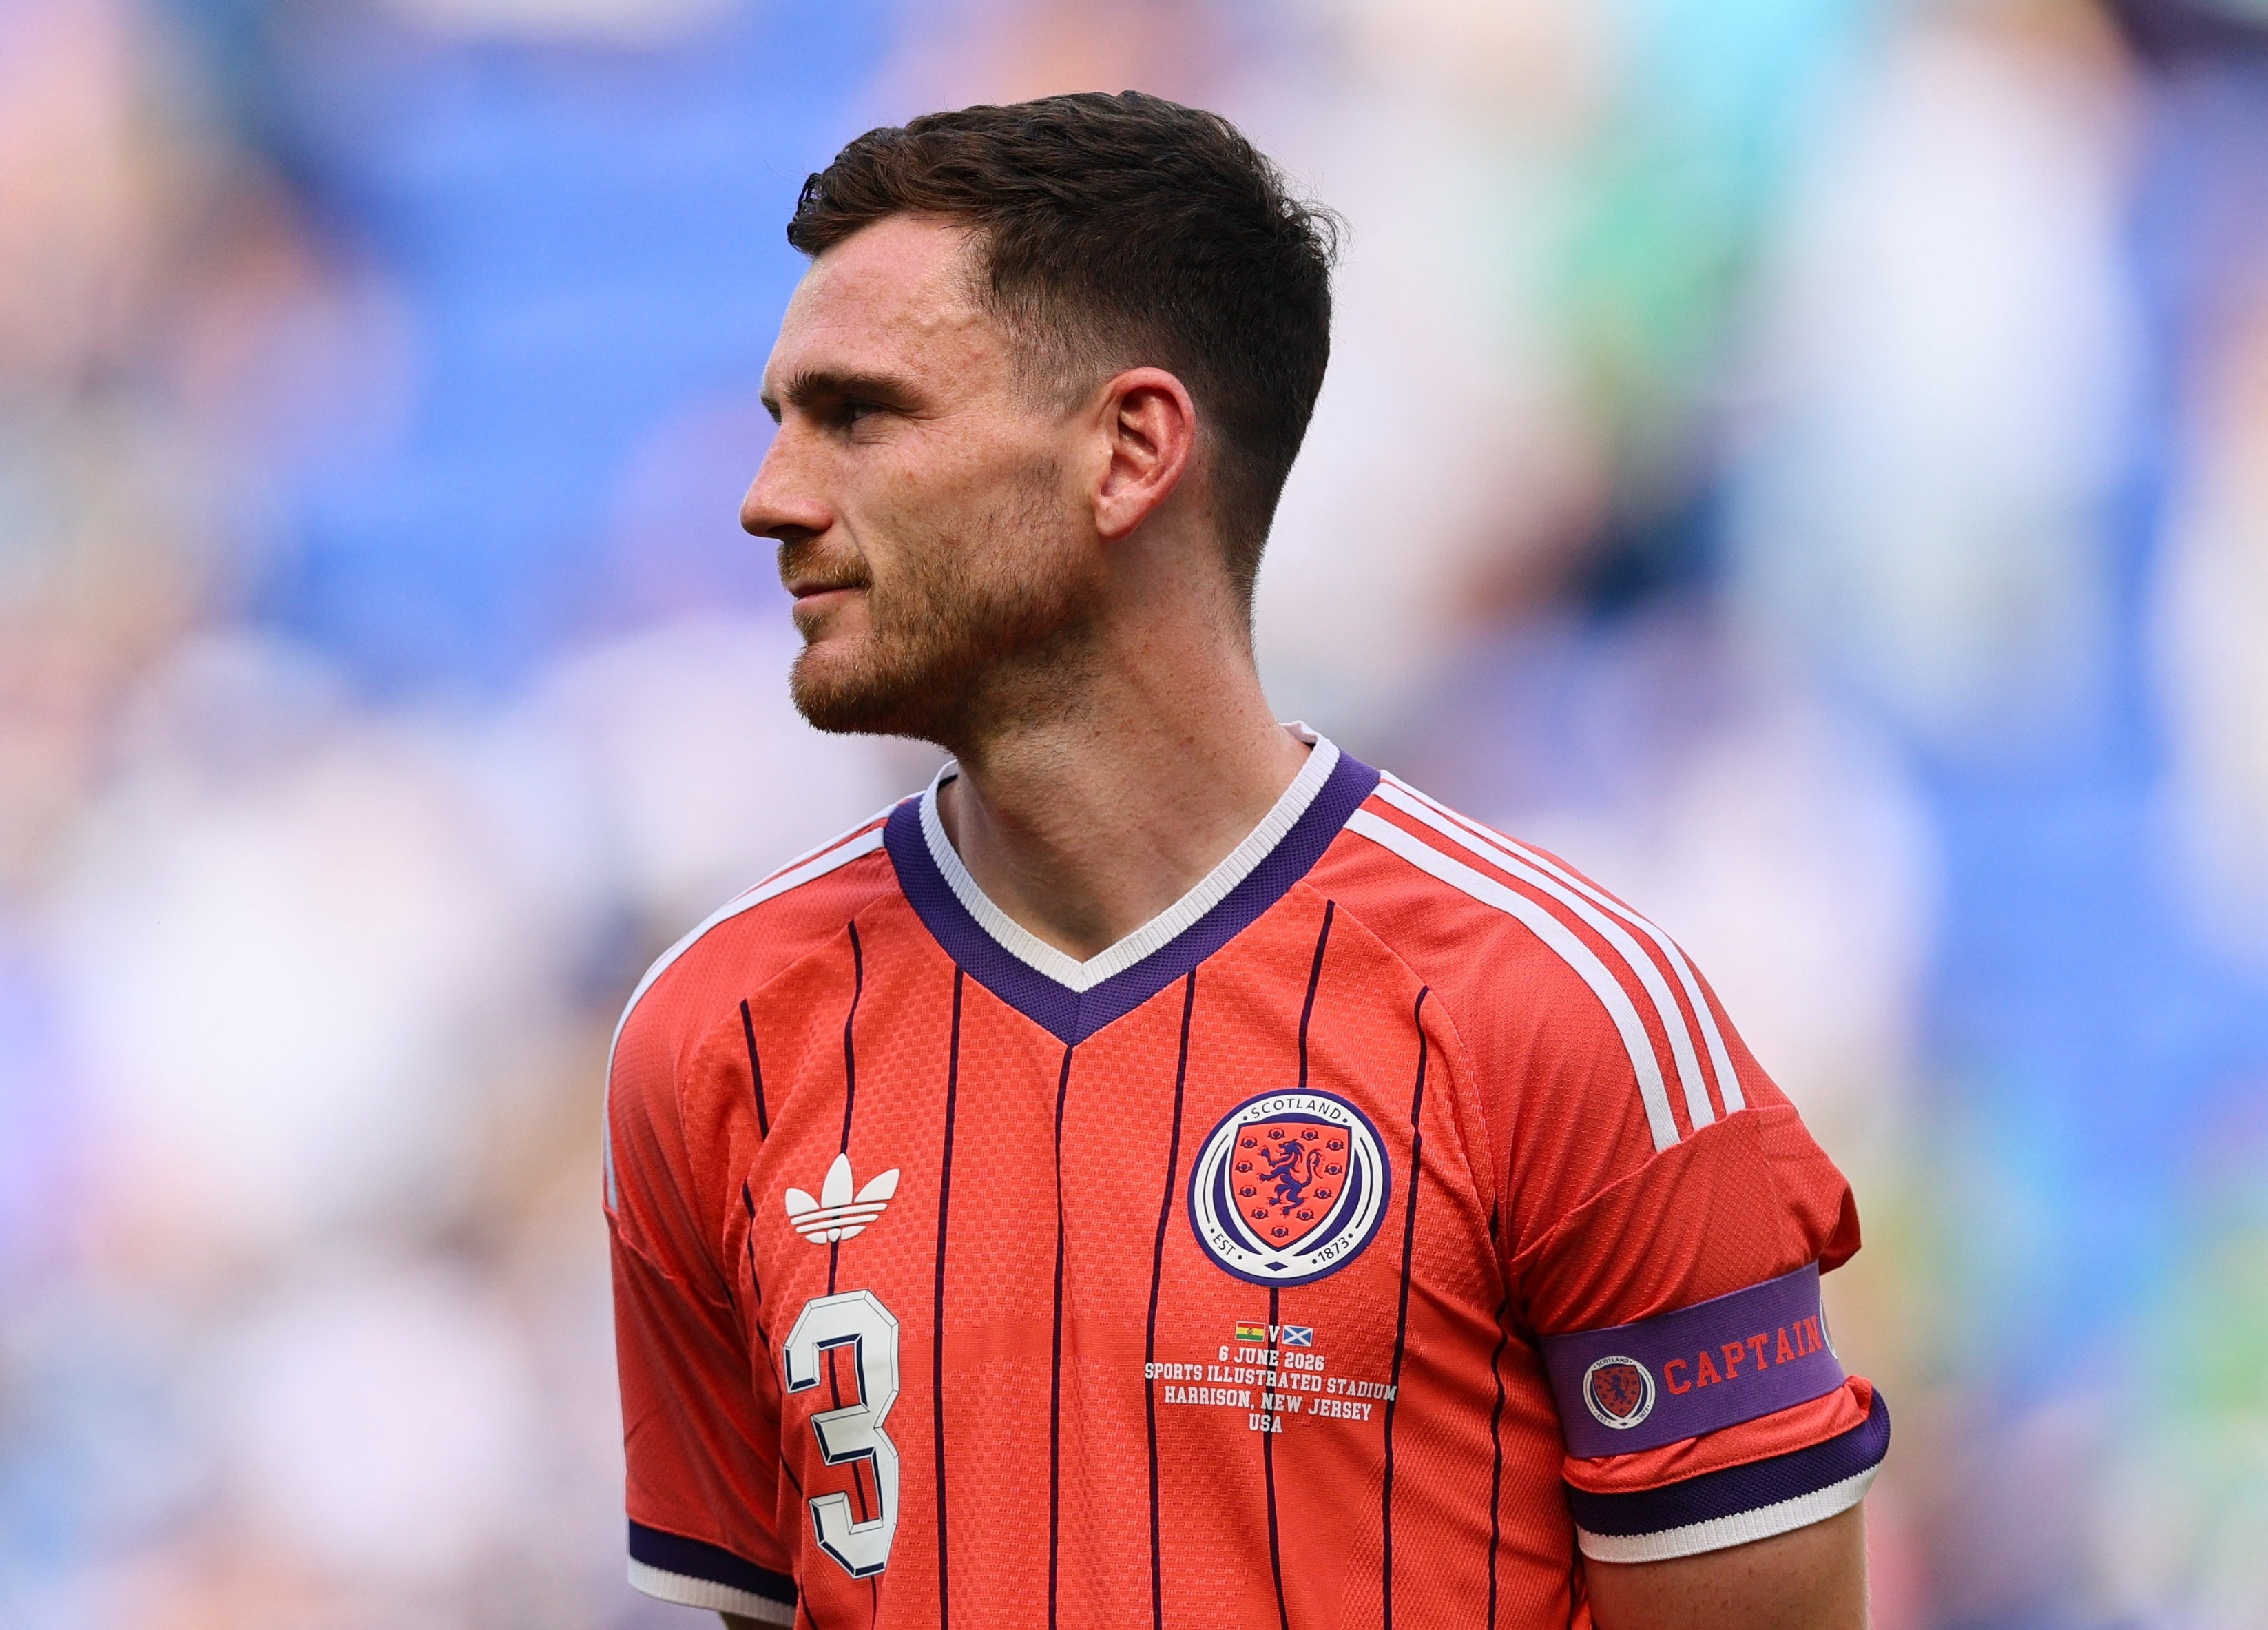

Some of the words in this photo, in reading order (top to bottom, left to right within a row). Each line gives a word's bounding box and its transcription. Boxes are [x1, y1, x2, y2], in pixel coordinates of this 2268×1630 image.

[1251, 1098, 1342, 1120] SCOTLAND
[1213, 1233, 1236, 1256] EST
[1318, 1237, 1350, 1263] 1873
[1269, 1325, 1280, 1343] V
[1218, 1345, 1229, 1362] 6
[1234, 1346, 1279, 1367] JUNE
[1284, 1351, 1325, 1372] 2026
[1596, 1356, 1630, 1367] SCOTLAND
[1663, 1314, 1824, 1395] CAPTAIN
[1145, 1363, 1203, 1381] SPORTS
[1207, 1365, 1322, 1392] ILLUSTRATED
[1327, 1378, 1397, 1401] STADIUM
[1164, 1385, 1255, 1410] HARRISON,
[1260, 1392, 1303, 1414] NEW
[1308, 1398, 1372, 1421] JERSEY
[782, 1288, 900, 1580] 3
[1249, 1413, 1283, 1433] USA
